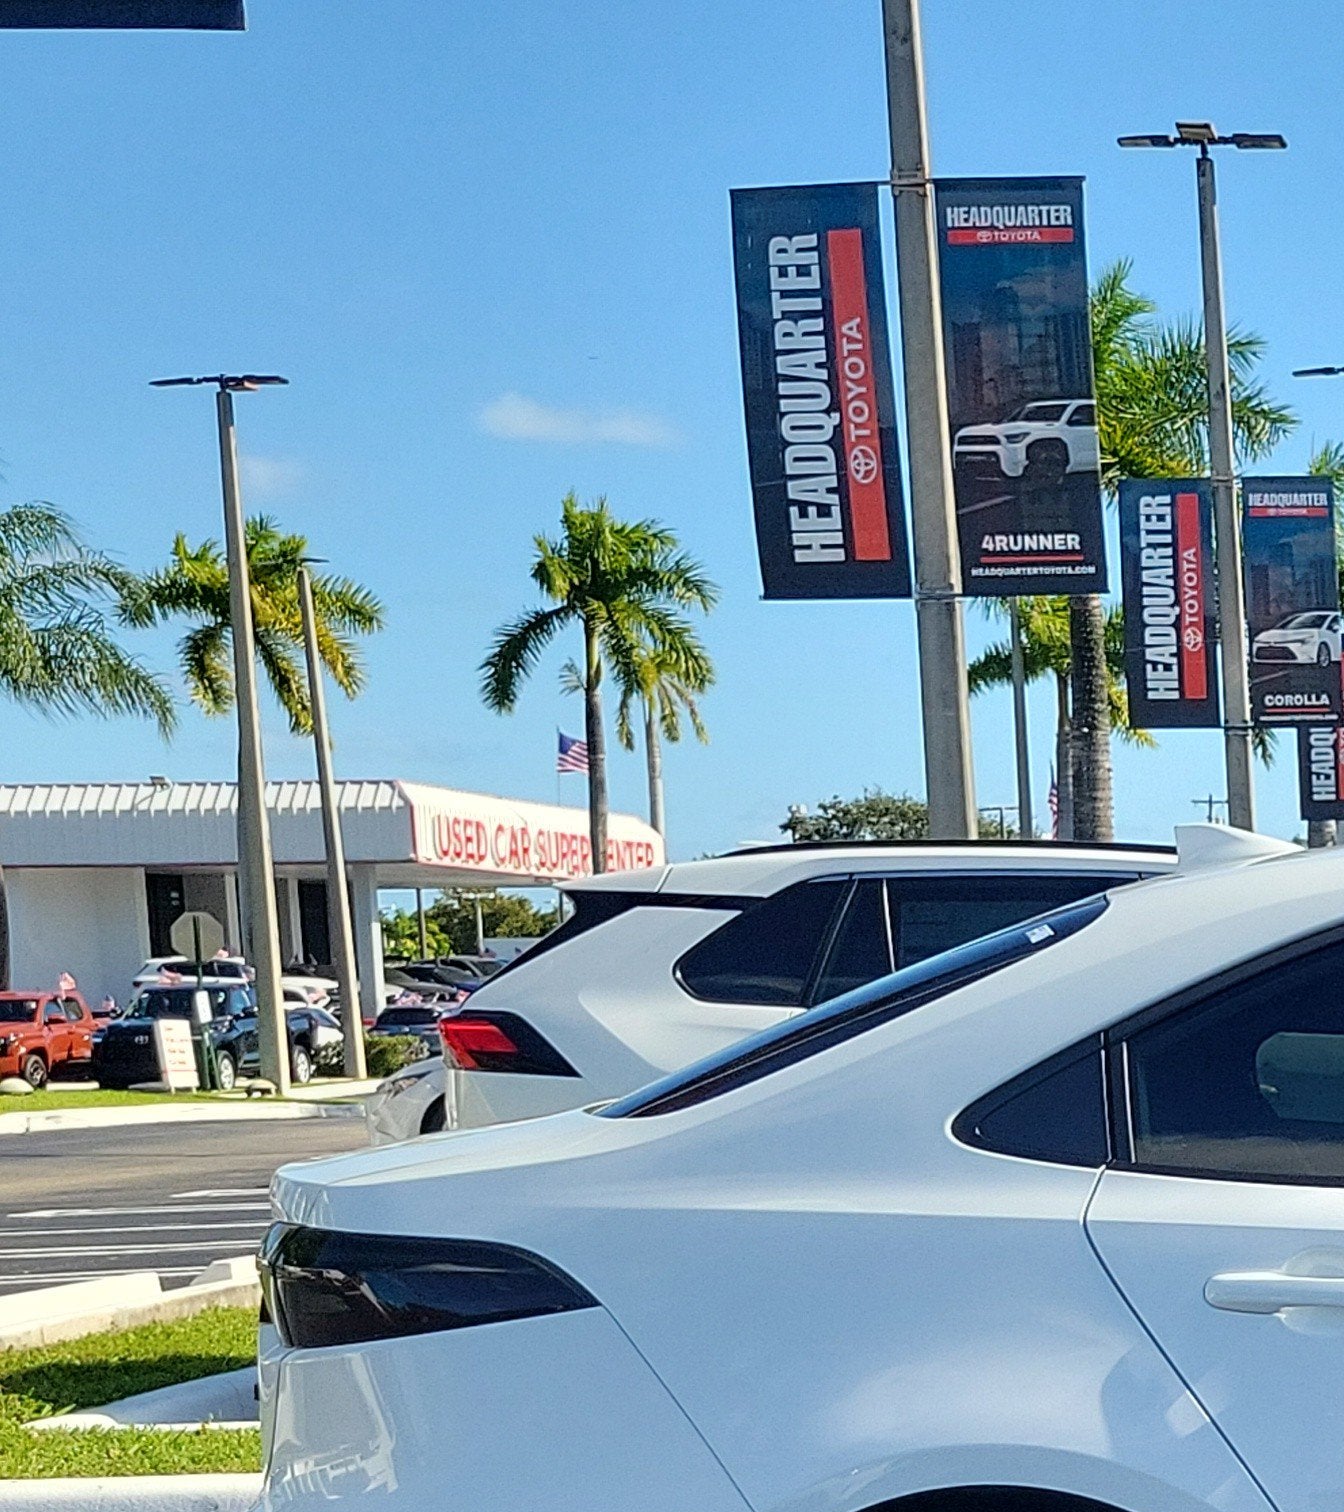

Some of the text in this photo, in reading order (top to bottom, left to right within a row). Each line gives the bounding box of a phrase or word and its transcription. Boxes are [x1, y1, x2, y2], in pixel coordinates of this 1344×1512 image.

[946, 204, 1073, 229] HEADQUARTER
[995, 230, 1041, 241] TOYOTA
[768, 232, 846, 563] HEADQUARTER
[840, 317, 872, 442] TOYOTA
[1248, 493, 1328, 508] HEADQUARTER
[981, 533, 1081, 552] 4RUNNER
[1139, 494, 1180, 700] HEADQUARTER
[1183, 548, 1199, 626] TOYOTA
[1264, 693, 1330, 706] COROLLA
[436, 814, 488, 863] USED
[494, 824, 532, 869] CAR
